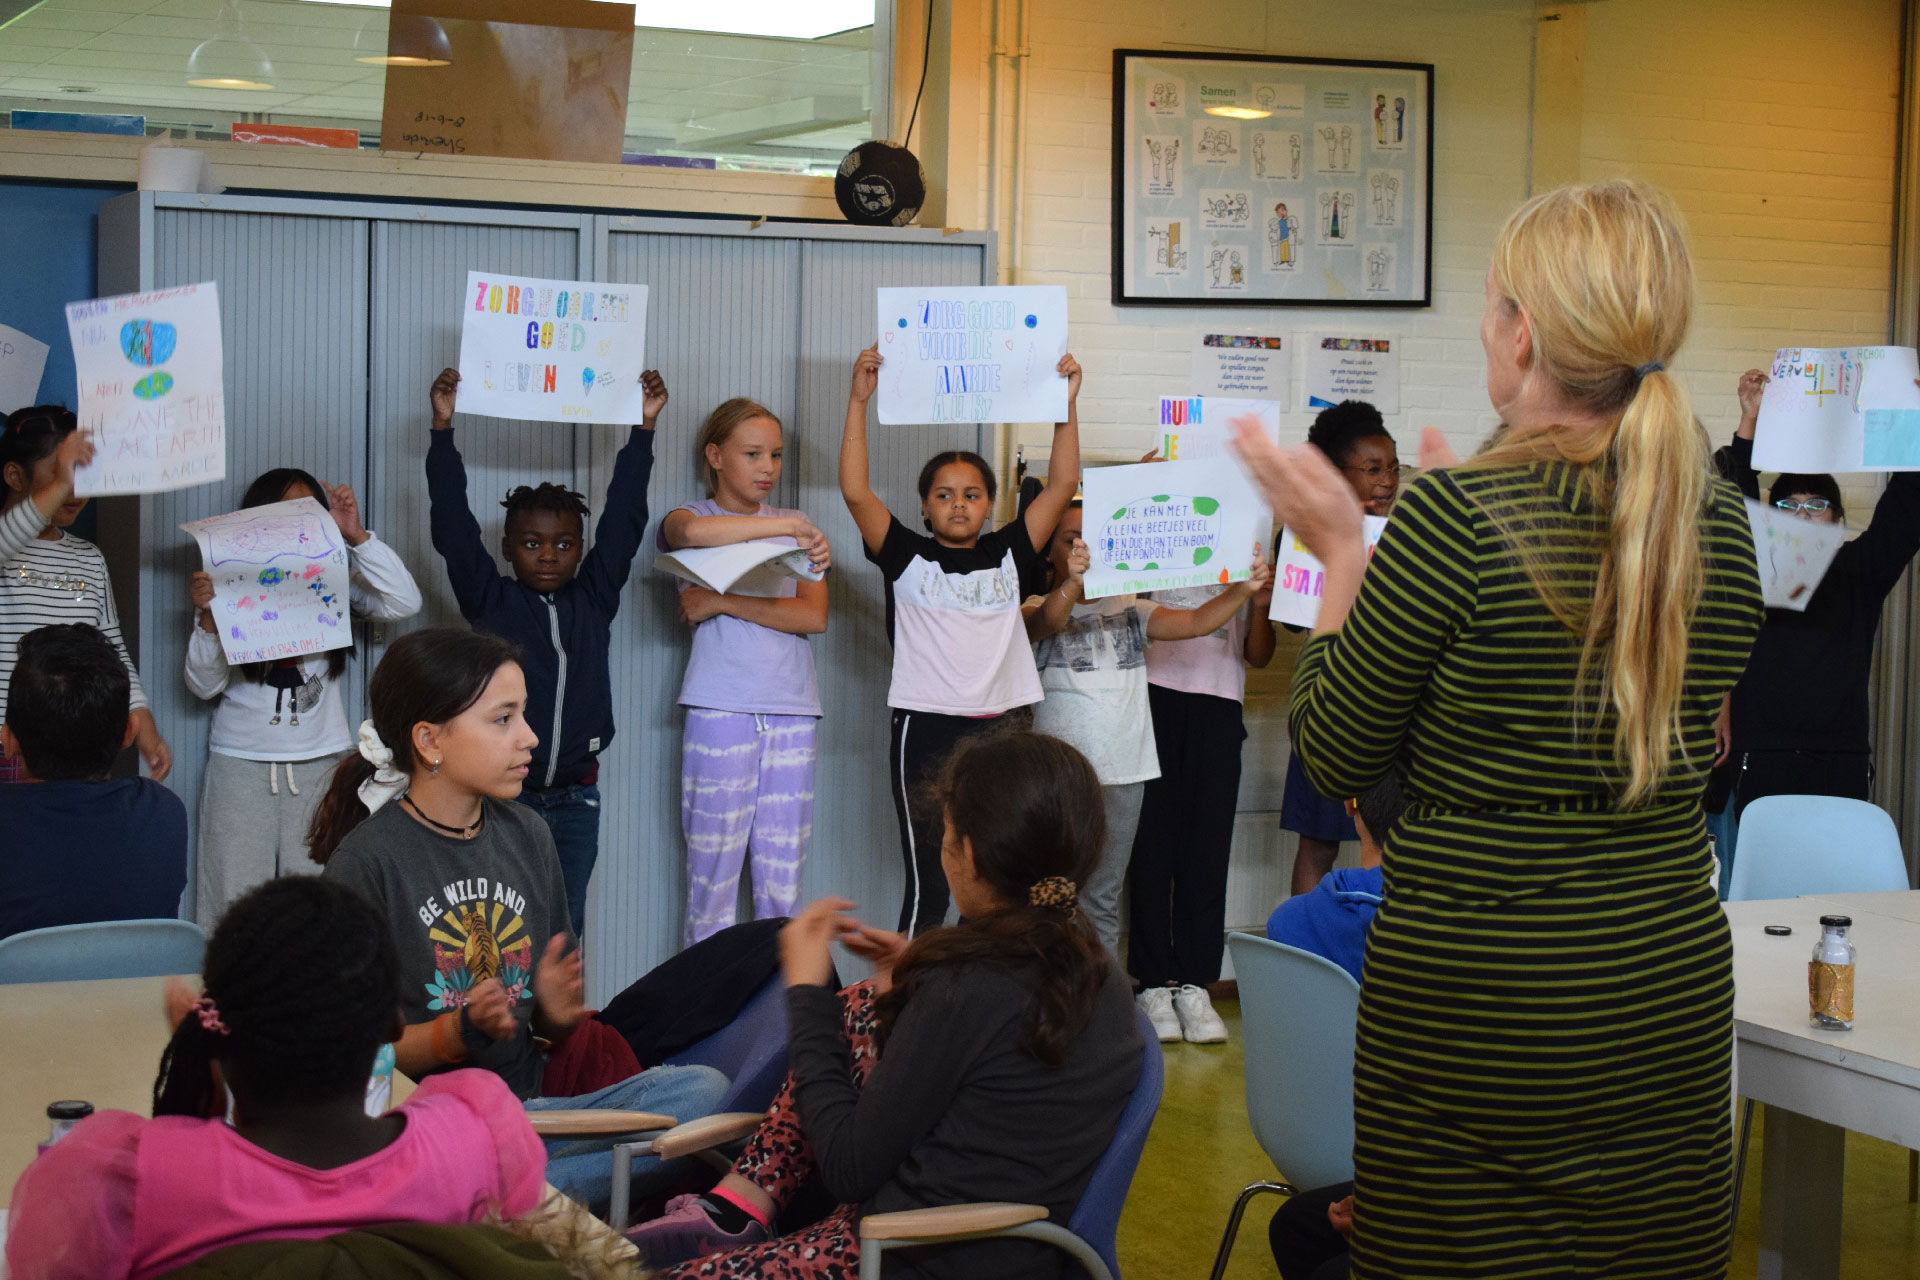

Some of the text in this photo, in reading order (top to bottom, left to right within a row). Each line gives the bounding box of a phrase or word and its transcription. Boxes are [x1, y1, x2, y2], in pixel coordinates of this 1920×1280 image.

[1201, 85, 1236, 97] Samen
[917, 300, 1016, 330] ZORG GOED
[526, 321, 586, 352] GOED
[917, 330, 993, 361] VOOR DE
[484, 361, 557, 393] LEVEN
[935, 364, 1001, 394] AARDE
[1161, 398, 1202, 426] RUIM
[1163, 434, 1179, 460] JE
[1125, 504, 1189, 520] JE KAN MET
[1100, 537, 1127, 551] DOEN
[1129, 537, 1143, 549] DUS
[1190, 533, 1215, 547] BOOM
[1106, 519, 1208, 537] KLEINE BEETJES VEEL
[1104, 550, 1114, 562] OF
[1115, 548, 1131, 562] EEN
[418, 878, 526, 927] BE WILD AND
